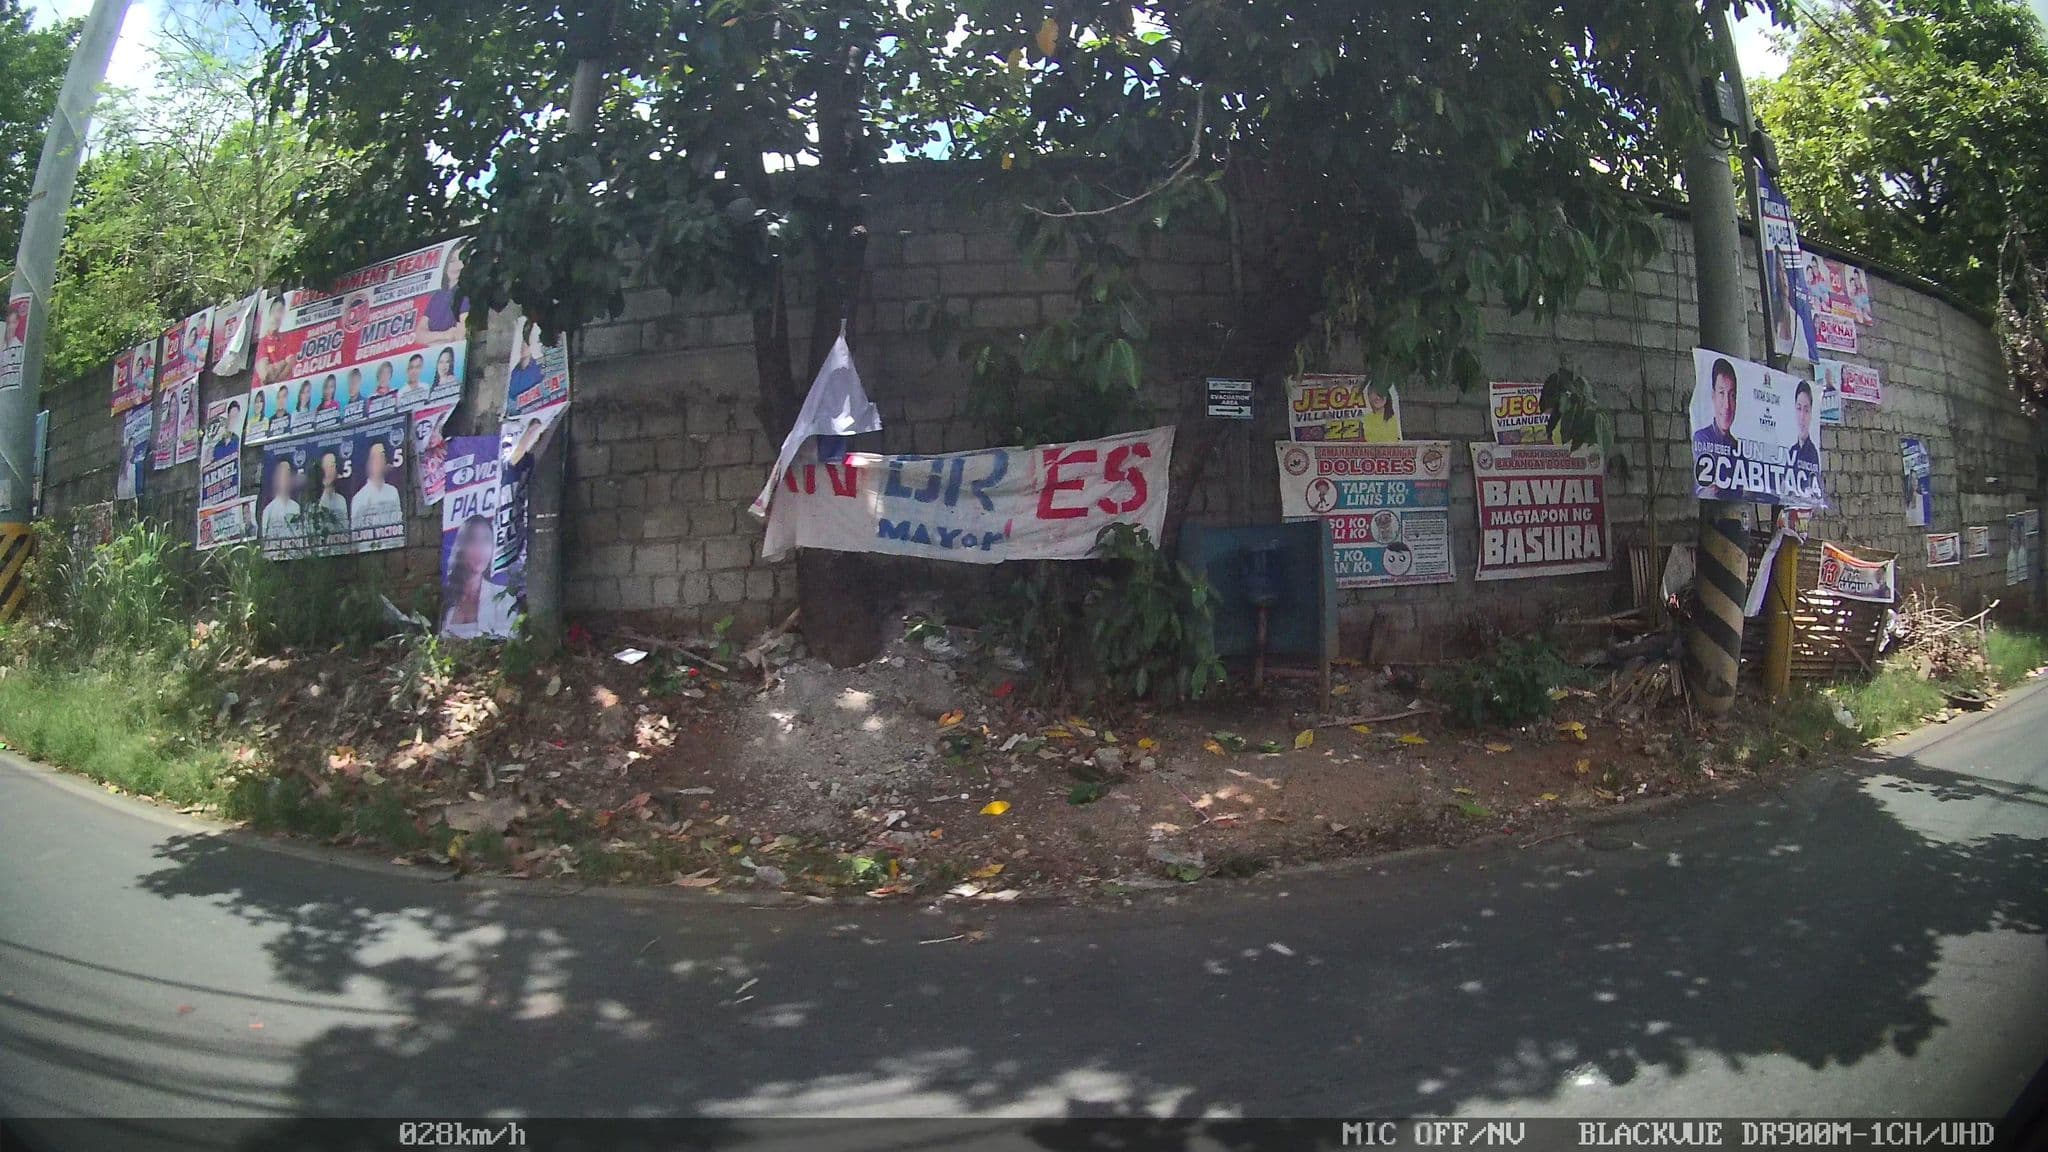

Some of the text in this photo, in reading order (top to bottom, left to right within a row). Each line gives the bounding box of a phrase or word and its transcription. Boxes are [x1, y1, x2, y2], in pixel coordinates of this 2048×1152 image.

[393, 251, 441, 280] TEAM
[359, 310, 418, 346] MITCH
[296, 328, 345, 362] JORIC
[293, 350, 343, 377] GACULA
[1292, 386, 1366, 413] JECA
[1495, 394, 1542, 418] JEC
[1296, 409, 1363, 422] VILLANUEVA
[1323, 420, 1361, 440] 22
[1520, 426, 1547, 443] 22
[392, 448, 404, 467] 5
[1732, 438, 1765, 462] JUN
[203, 462, 236, 487] ARNEL
[342, 459, 353, 478] 5
[475, 460, 498, 481] VIC
[1318, 458, 1417, 476] DOLORES
[1698, 456, 1822, 497] 2 CABITACA
[1342, 482, 1384, 495] TAPAT
[1387, 482, 1409, 496] KO,
[1482, 479, 1600, 507] BAWAL
[450, 491, 478, 522] PIA
[1346, 494, 1406, 506] LINIS KO
[1329, 517, 1370, 530] SO KO,
[1491, 508, 1593, 526] MAGTAPON NG
[374, 525, 405, 539] VICTOR
[1350, 528, 1367, 540] KO
[1484, 524, 1601, 566] BASURA
[1344, 550, 1367, 563] KO,
[1353, 561, 1373, 574] KO
[1823, 562, 1839, 584] 13
